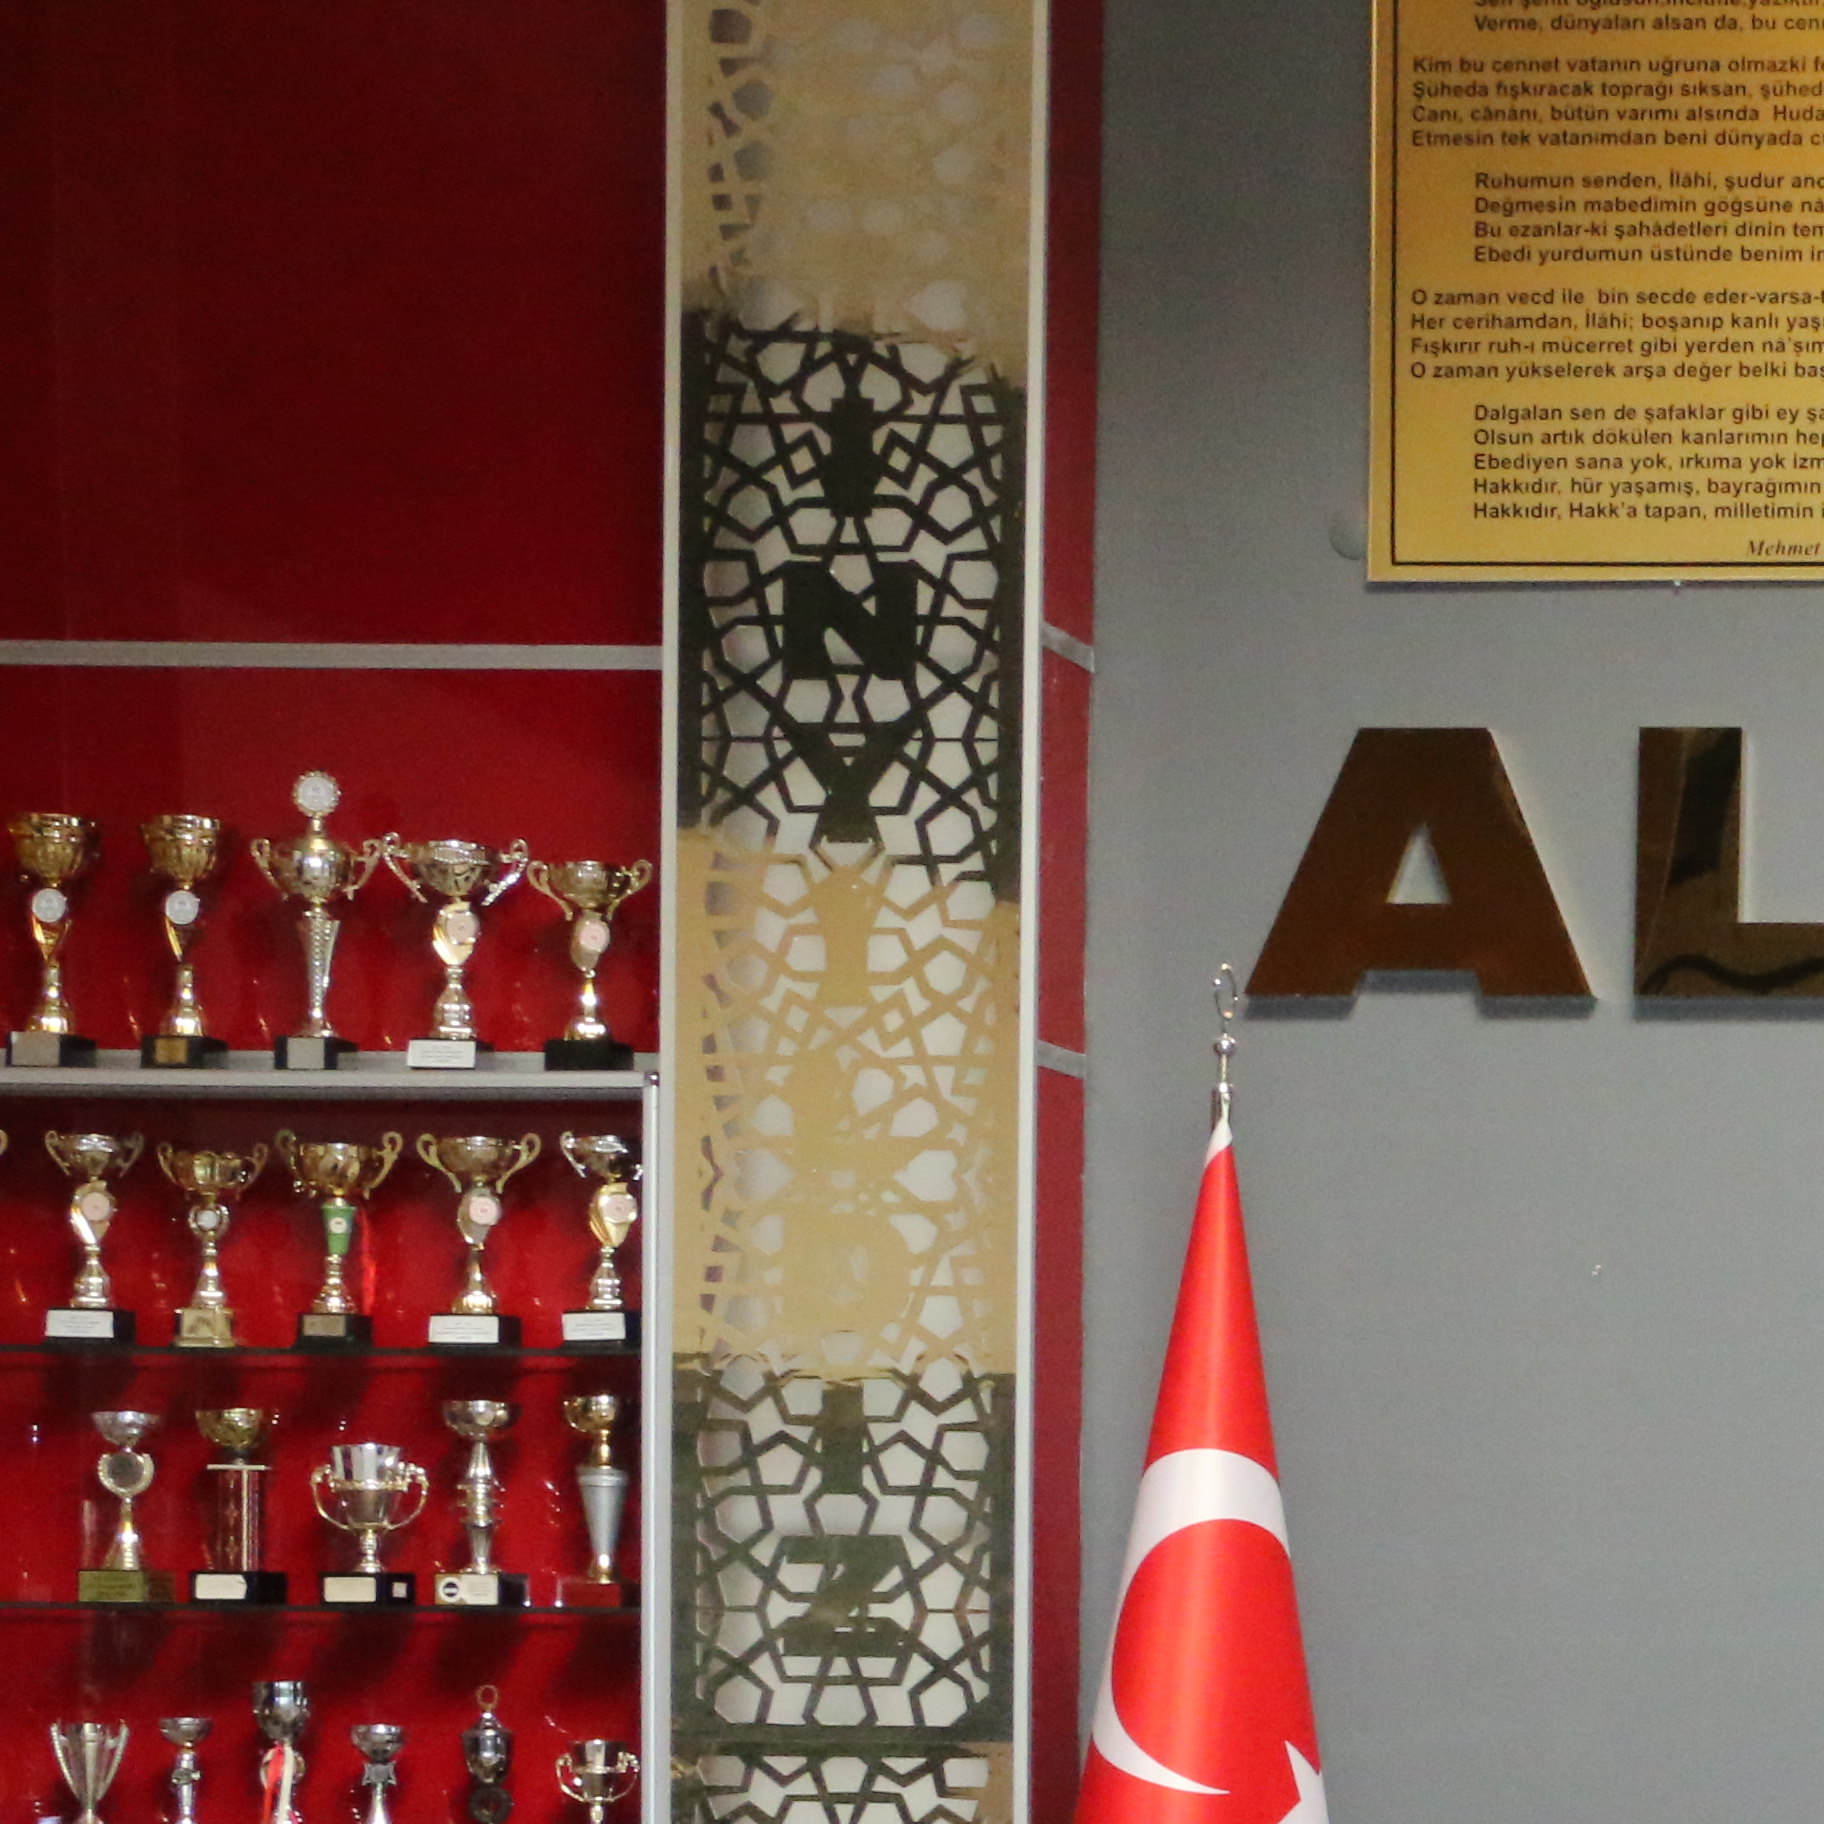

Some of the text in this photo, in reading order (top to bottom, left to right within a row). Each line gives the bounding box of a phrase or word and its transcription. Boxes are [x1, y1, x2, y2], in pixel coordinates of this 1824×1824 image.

[1411, 288, 1428, 306] O
[1433, 292, 1500, 306] zaman
[1506, 288, 1555, 305] vecd
[1562, 288, 1590, 306] ile
[1597, 288, 1629, 305] bin
[1636, 287, 1697, 305] secde
[1410, 313, 1446, 330] Her
[1452, 312, 1578, 331] cerihamdan,
[1641, 312, 1724, 333] boşanıp
[1731, 312, 1779, 329] kanlı
[1411, 336, 1482, 358] Fışkırır
[1488, 337, 1535, 354] ruh-ı
[1541, 337, 1634, 354] mücerret
[1640, 336, 1677, 358] gibi
[1685, 336, 1755, 358] yerden
[1410, 361, 1427, 379] O
[1432, 365, 1499, 379] zaman
[1505, 361, 1616, 383] yükselerek
[1623, 365, 1667, 382] arşa
[1738, 361, 1787, 378] belki
[1474, 403, 1563, 426] Dalgalan
[1569, 407, 1606, 421] sen
[1613, 404, 1638, 421] de
[1644, 403, 1726, 425] şafaklar
[1731, 403, 1770, 425] gibi
[1776, 407, 1800, 425] ey
[1473, 428, 1534, 446] Olsun
[1540, 428, 1585, 445] artık
[1592, 428, 1673, 445] dökülen
[1681, 427, 1788, 446] kanlarımın
[1473, 452, 1568, 475] Ebediyen
[1575, 456, 1623, 470] sana
[1630, 452, 1672, 475] yok,
[1680, 453, 1742, 470] ırkıma
[1749, 452, 1786, 474] yok
[1473, 477, 1562, 496] Hakkıdır,
[1570, 477, 1603, 494] hür
[1609, 481, 1700, 498] yaşamış,
[1473, 502, 1562, 521] Hakkıdır,
[1568, 501, 1638, 519] Hakk'a
[1644, 503, 1707, 522] tapan,
[1714, 501, 1814, 519] milletimin
[1747, 538, 1821, 557] Mehmet
